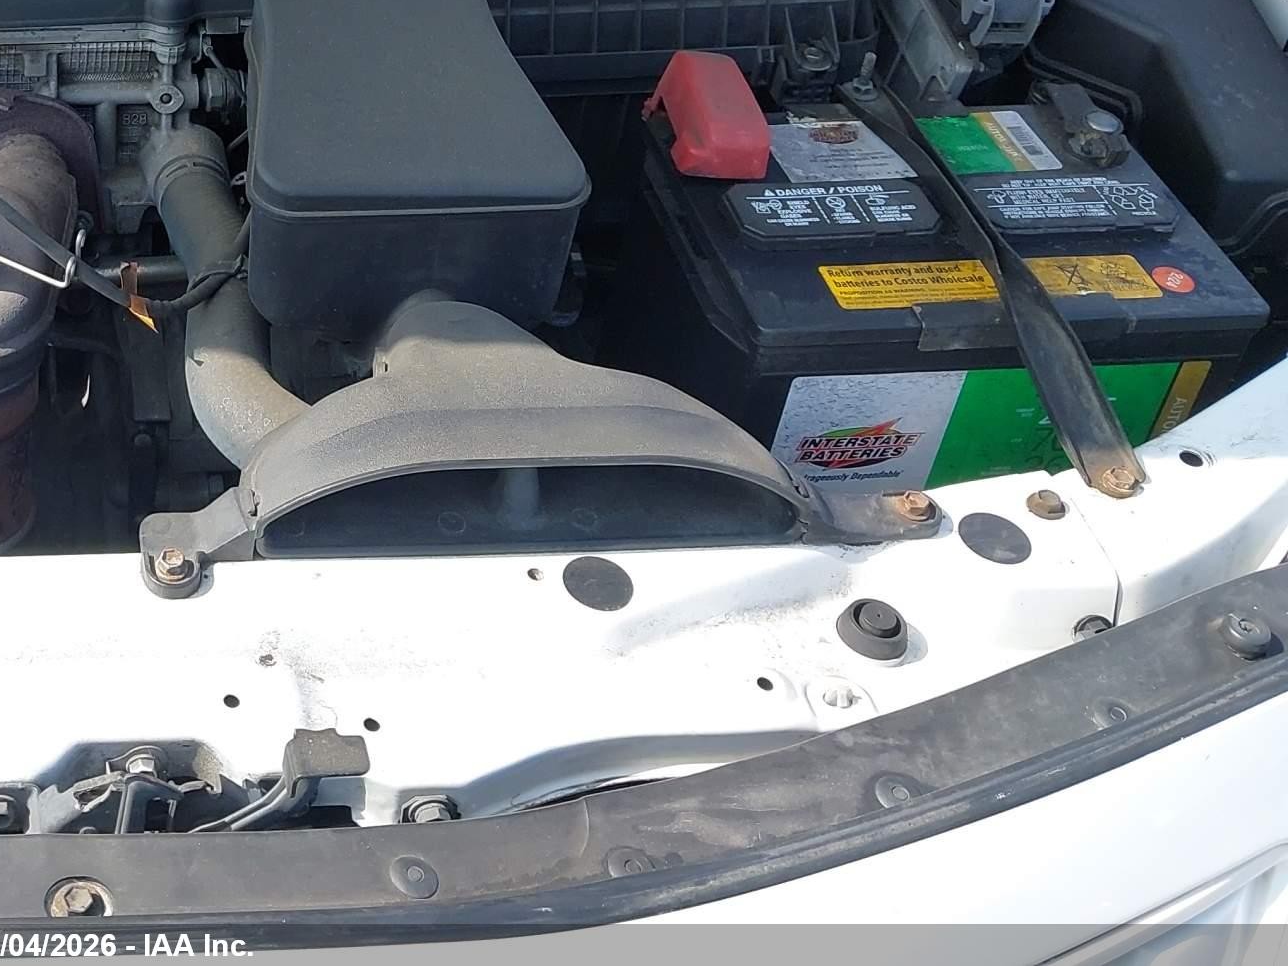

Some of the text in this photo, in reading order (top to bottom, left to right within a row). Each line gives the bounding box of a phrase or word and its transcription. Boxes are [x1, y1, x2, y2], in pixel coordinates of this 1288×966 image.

[776, 187, 827, 196] DANGER
[839, 185, 884, 194] POISON
[827, 264, 960, 278] Return warranty and used
[834, 274, 985, 288] batteries to Costco Wholesale
[1162, 397, 1188, 434] AUTO
[800, 434, 917, 449] INTERSTATE
[799, 446, 907, 461] BATTERIES
